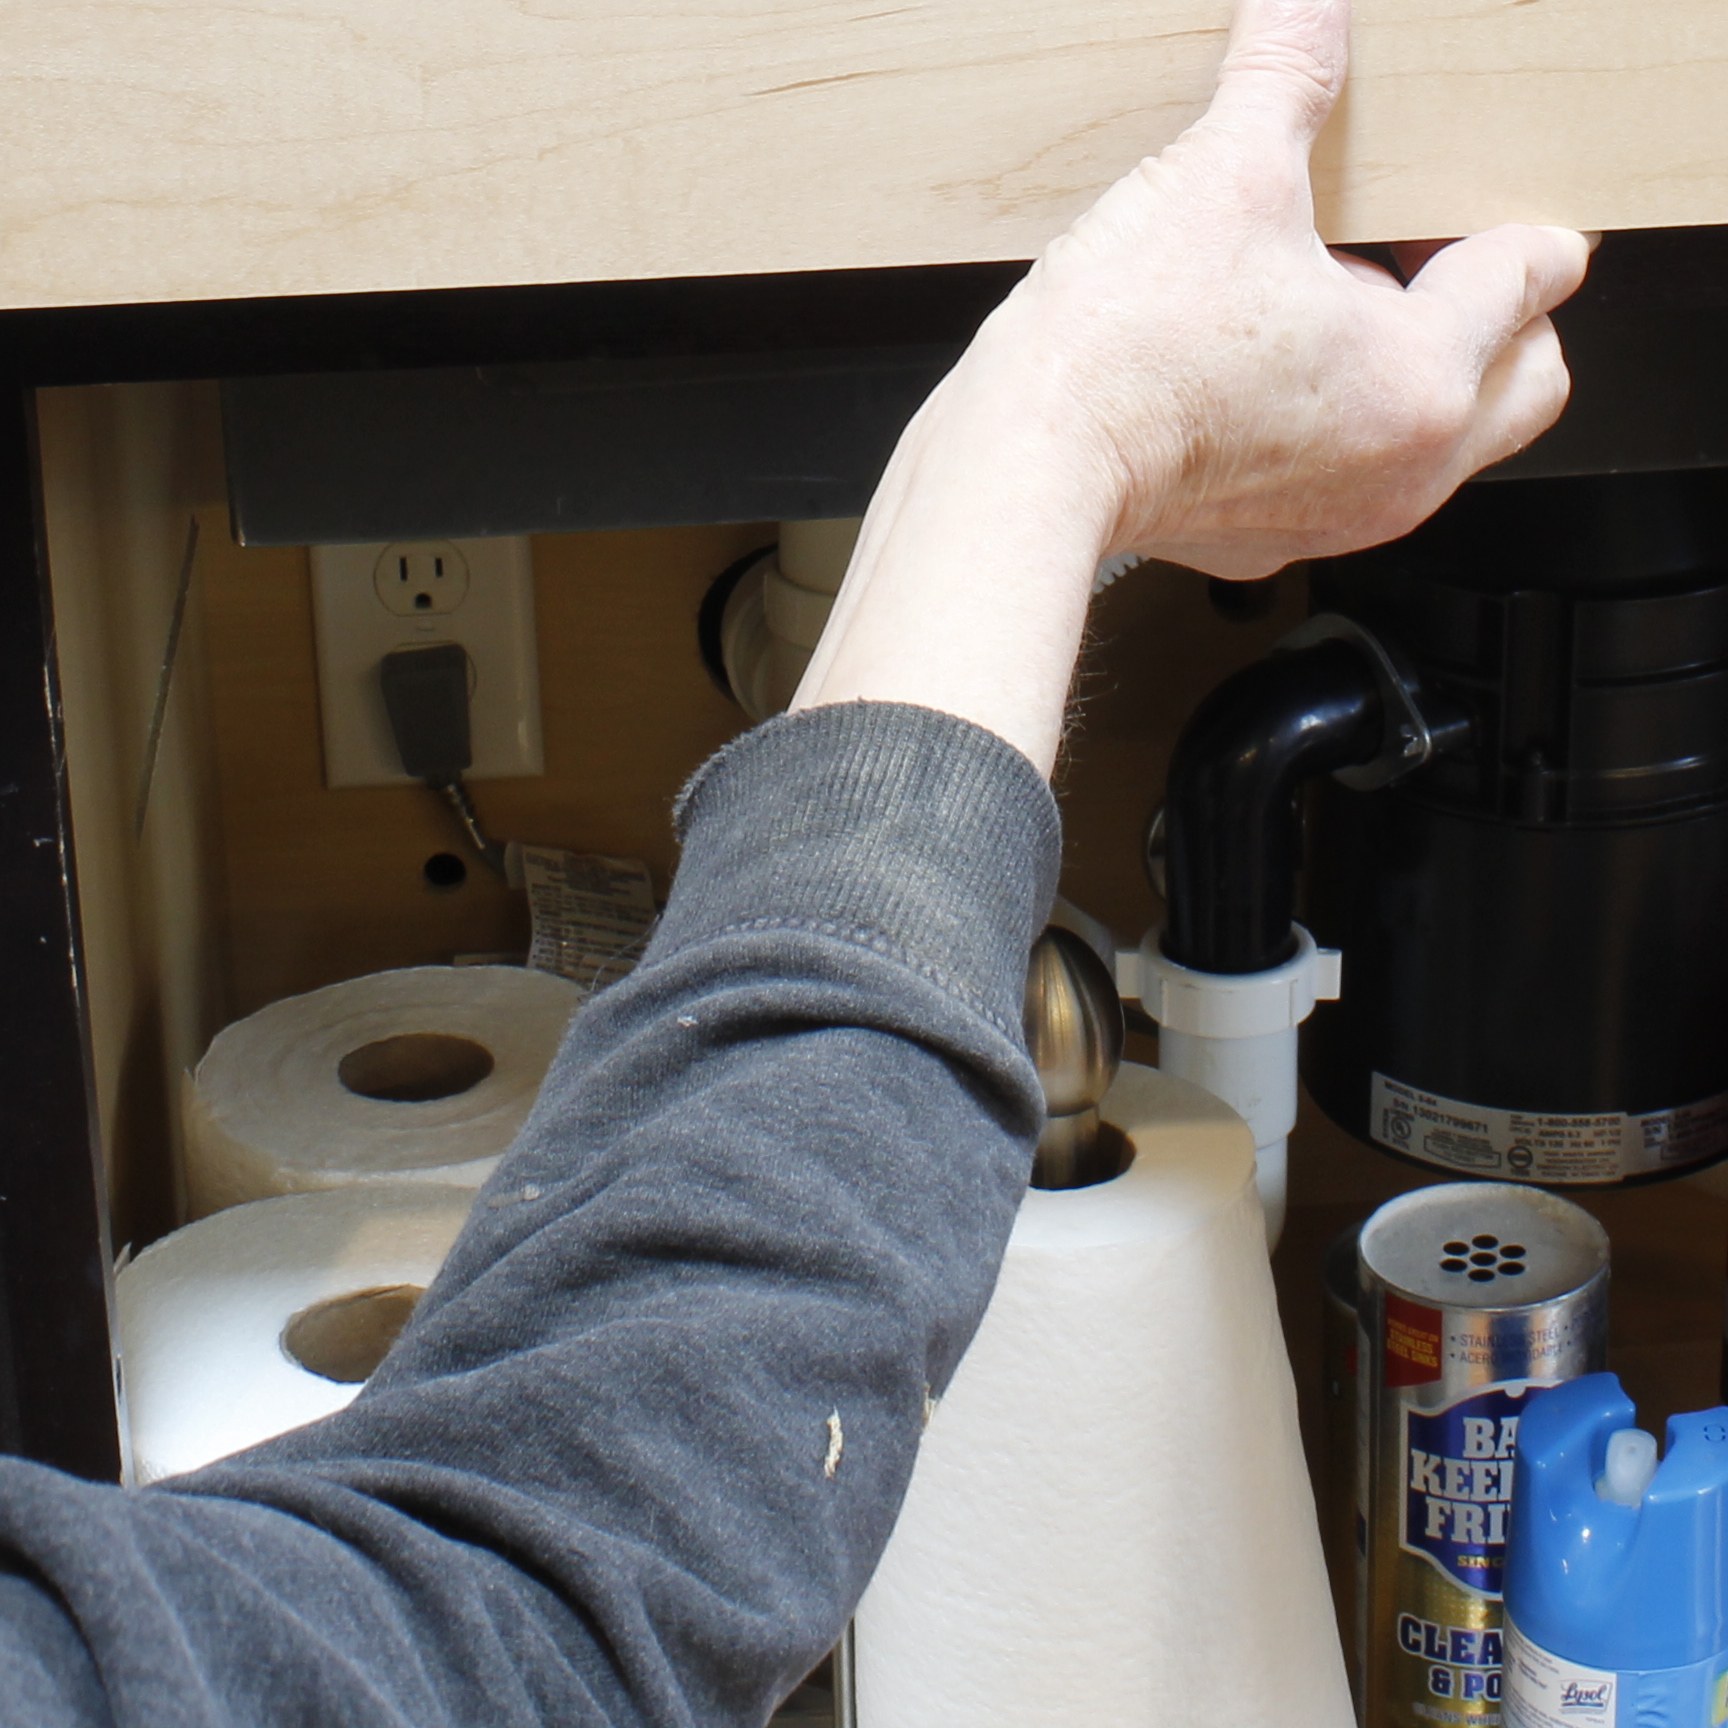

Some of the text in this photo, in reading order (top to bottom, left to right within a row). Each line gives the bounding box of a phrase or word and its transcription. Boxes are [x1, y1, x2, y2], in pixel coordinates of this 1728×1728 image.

[1463, 1415, 1520, 1459] BA
[1425, 1495, 1512, 1545] FRI
[1398, 1613, 1502, 1666] CLEA
[1429, 1665, 1502, 1702] & PO
[1561, 1682, 1608, 1703] Lysol
